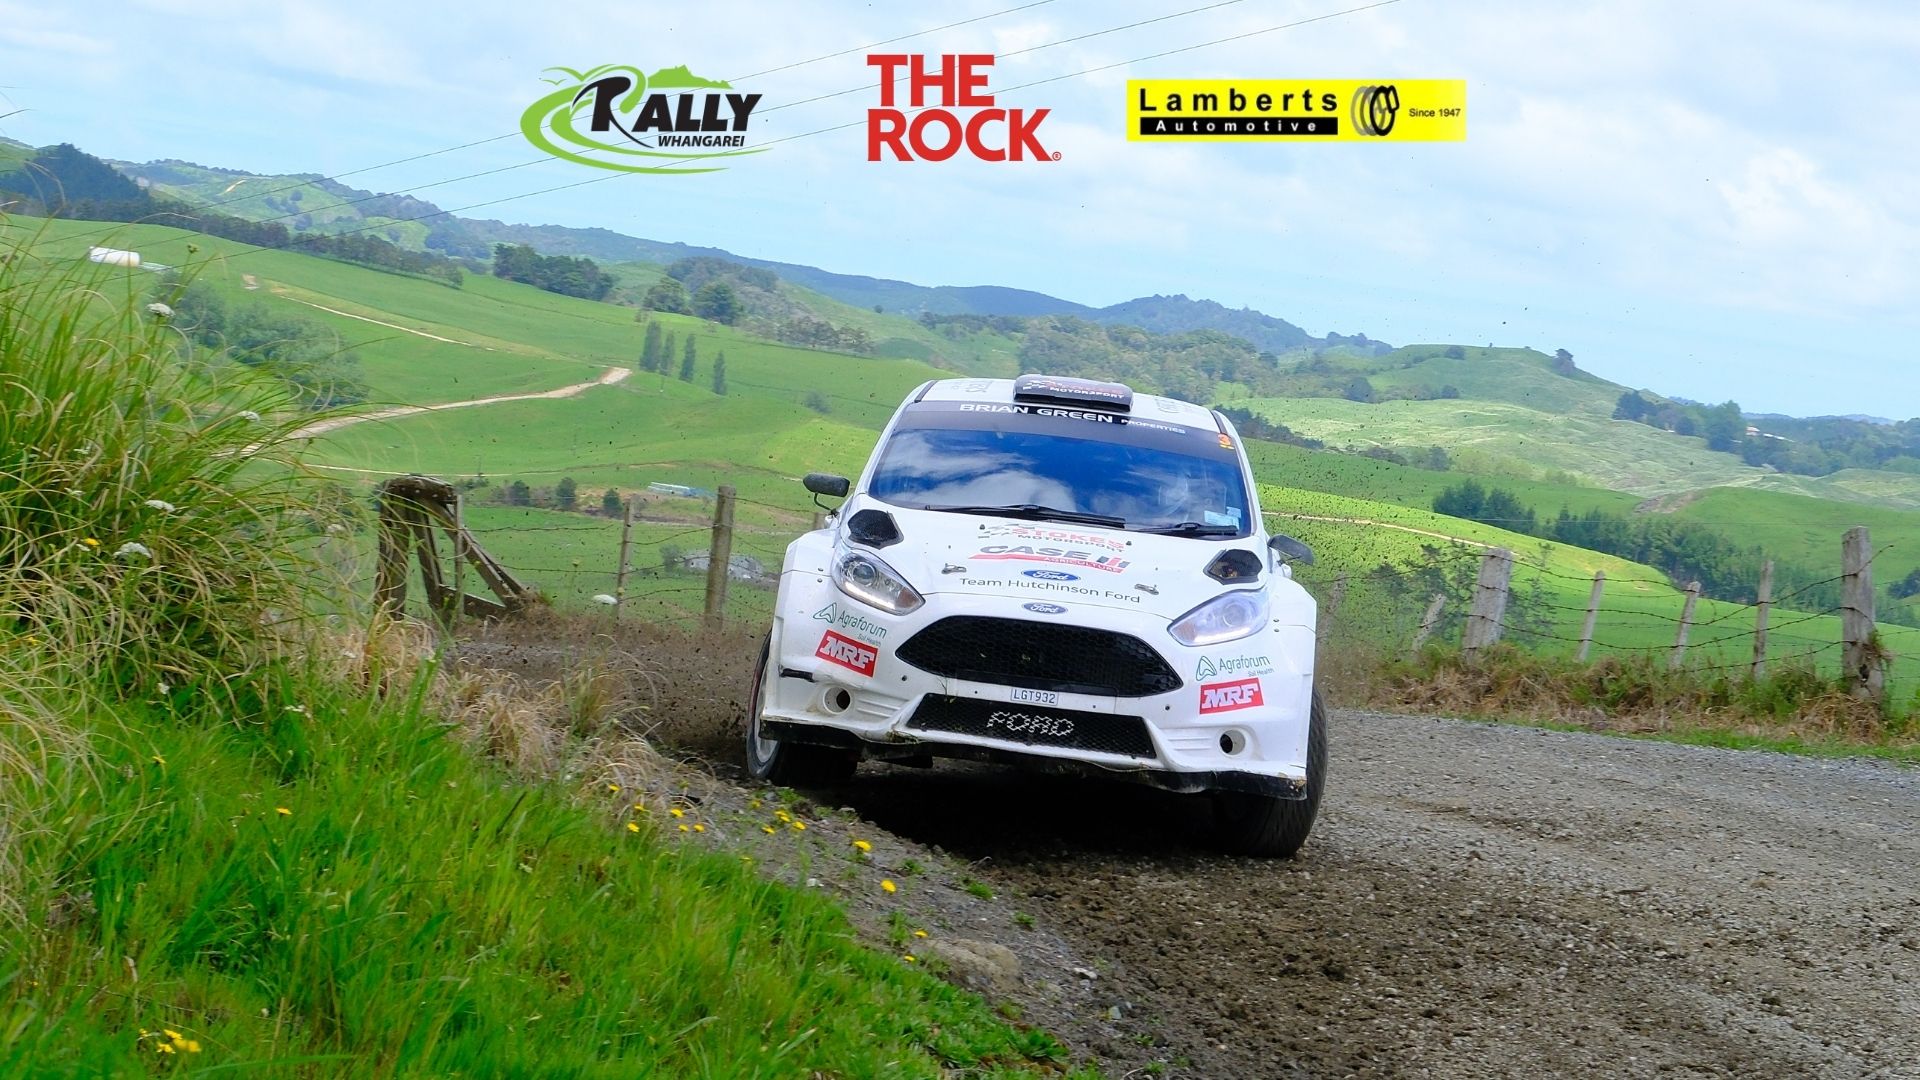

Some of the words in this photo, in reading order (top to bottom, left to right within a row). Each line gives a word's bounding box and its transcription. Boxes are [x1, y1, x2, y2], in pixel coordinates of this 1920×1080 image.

[959, 403, 1028, 414] BRIAN
[1037, 408, 1113, 423] GREEN
[1120, 418, 1186, 434] PROPERTIES
[1012, 527, 1125, 549] STOKES
[1017, 534, 1125, 553] MOTORSPORT
[980, 546, 1092, 560] CASE
[1030, 569, 1072, 581] Ford
[960, 578, 1002, 587] Team
[1008, 580, 1099, 597] Hutchinson
[1105, 591, 1140, 604] Ford
[1030, 603, 1064, 614] Ford
[837, 610, 887, 639] Agraforum
[820, 635, 876, 669] MRF
[1219, 655, 1271, 674] Agraforum
[1013, 689, 1056, 704] LGT932
[1201, 683, 1259, 709] MRF
[986, 711, 1075, 737] FORD
